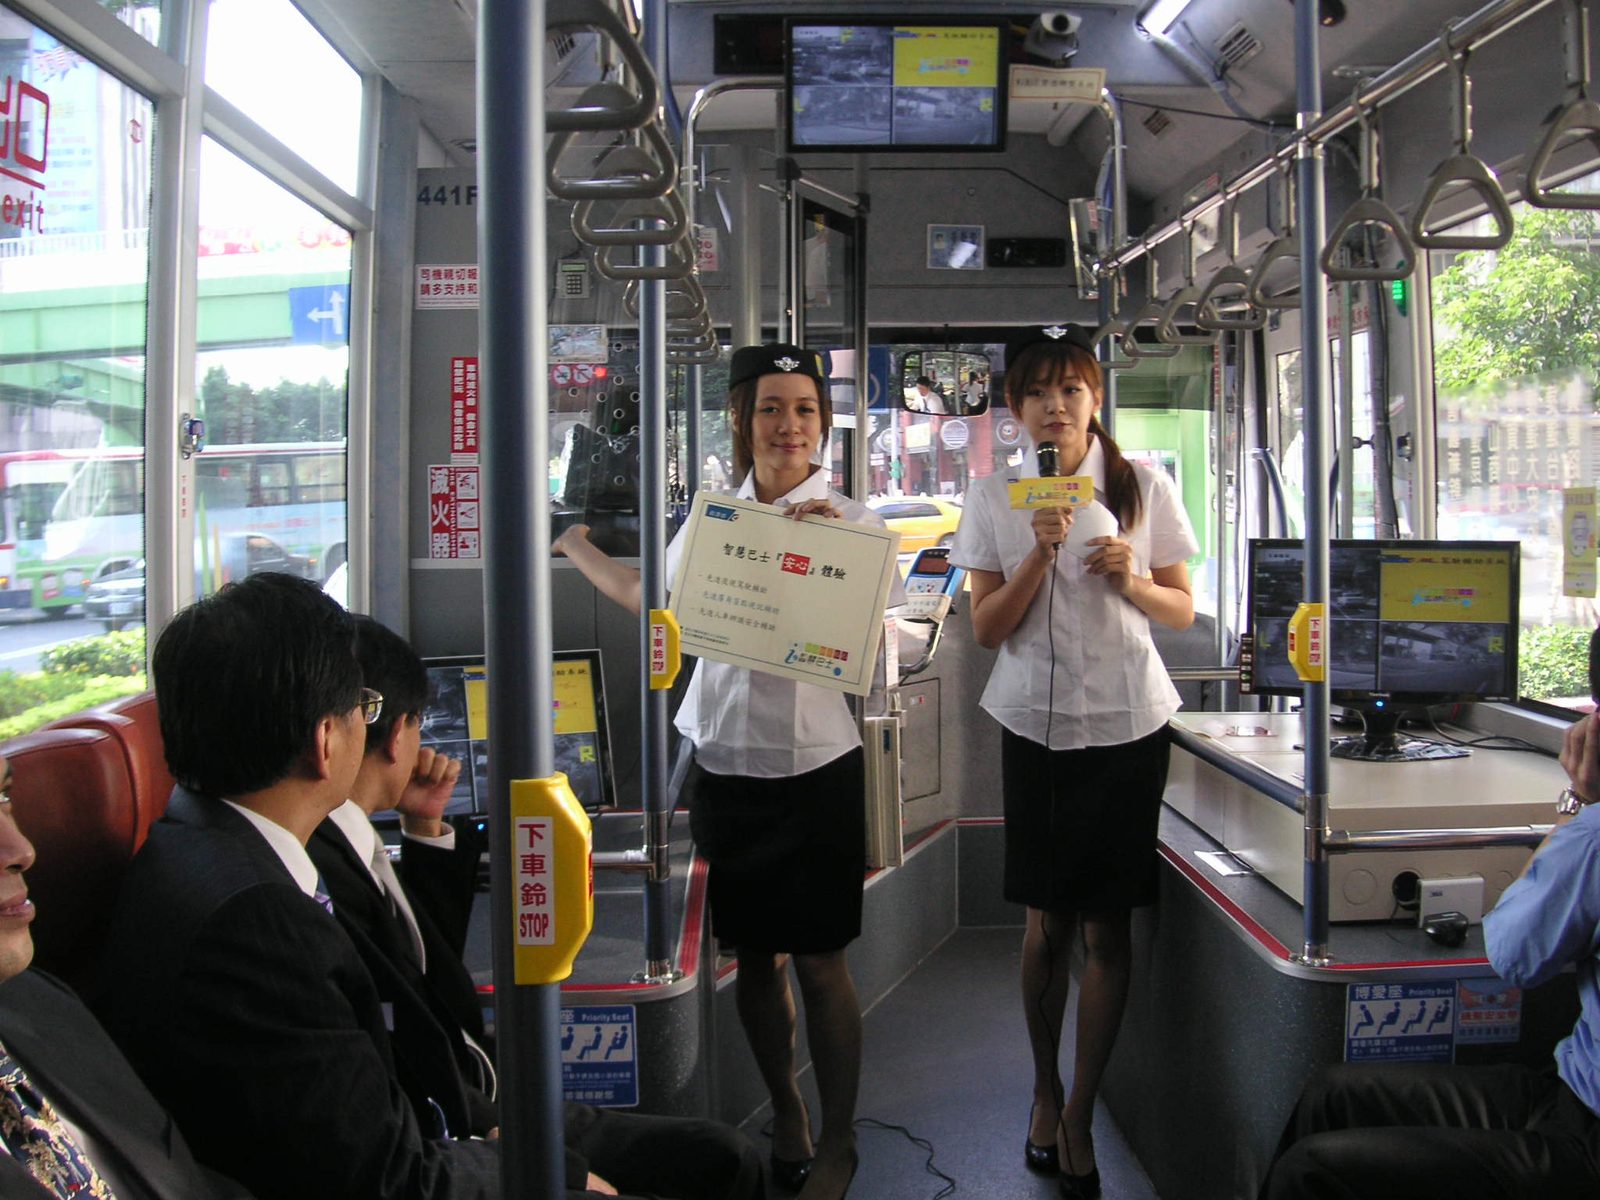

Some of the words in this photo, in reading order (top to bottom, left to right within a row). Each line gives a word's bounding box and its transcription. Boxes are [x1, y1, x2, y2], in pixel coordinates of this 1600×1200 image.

[2, 190, 44, 234] exit
[431, 467, 450, 558] 滅火器
[579, 745, 596, 763] R
[518, 823, 547, 907] 下車鈴
[519, 912, 549, 938] STOP
[1354, 984, 1403, 1000] 博愛座
[581, 1013, 610, 1022] Priority
[611, 1012, 630, 1021] Seat
